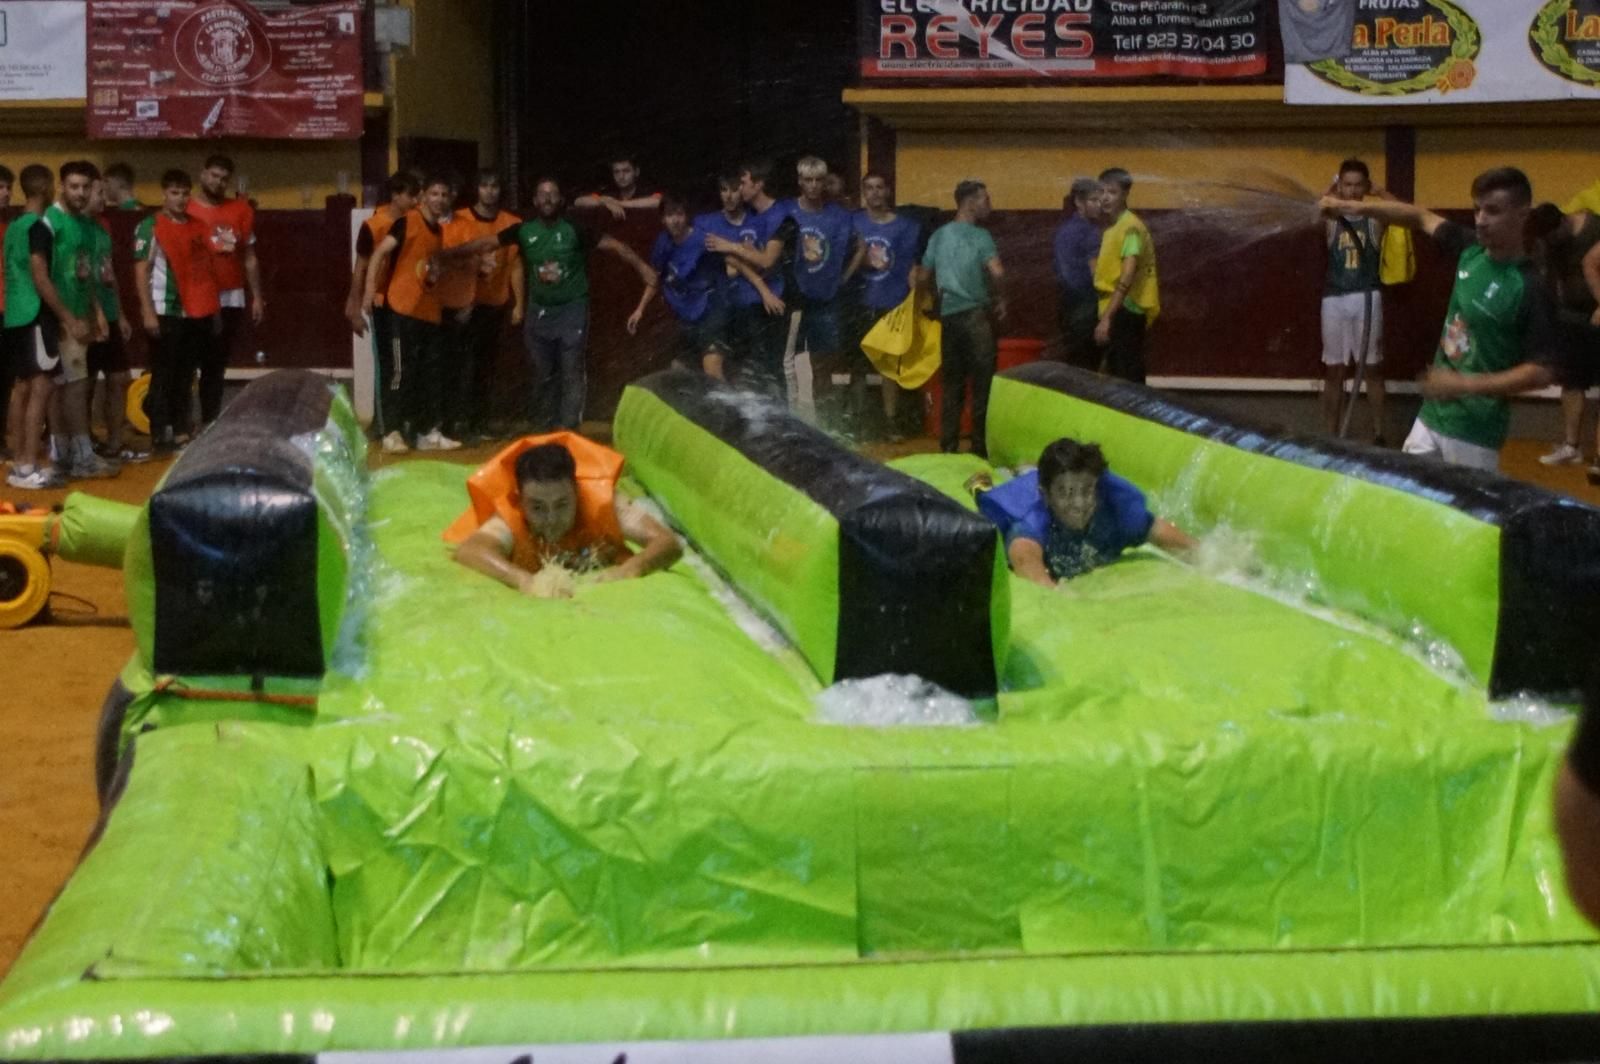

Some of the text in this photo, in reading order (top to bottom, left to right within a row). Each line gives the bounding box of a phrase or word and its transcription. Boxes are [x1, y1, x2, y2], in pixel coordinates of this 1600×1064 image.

[1111, 15, 1136, 26] Alba
[1139, 15, 1153, 24] de
[1375, 15, 1449, 48] Perla
[881, 13, 1094, 58] REYES
[1113, 35, 1142, 50] Telf
[1147, 33, 1177, 50] 923
[1201, 37, 1226, 52] 04
[1230, 33, 1255, 50] 30
